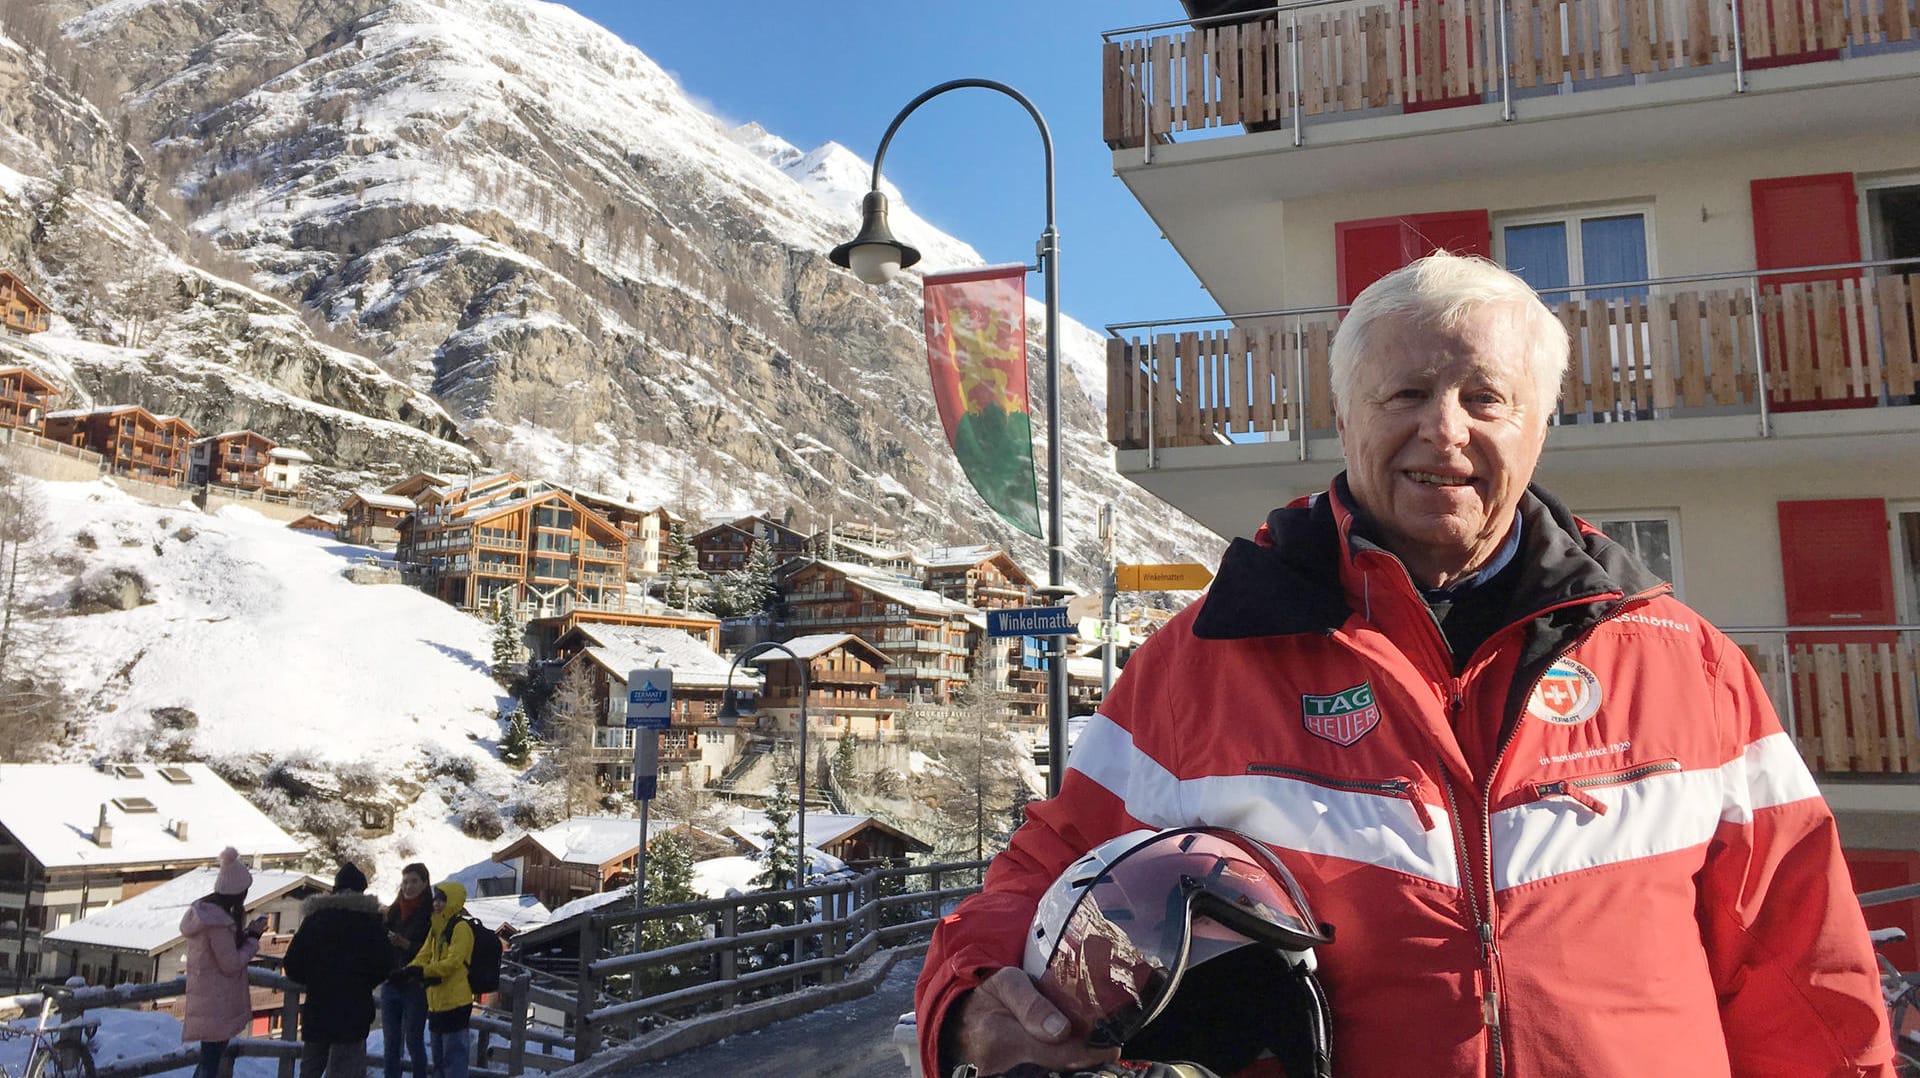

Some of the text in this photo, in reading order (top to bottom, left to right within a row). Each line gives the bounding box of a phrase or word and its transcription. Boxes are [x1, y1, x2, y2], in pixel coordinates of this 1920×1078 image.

[1309, 687, 1372, 714] TAG
[1308, 708, 1376, 741] HEUER
[1539, 756, 1550, 765] in
[1552, 751, 1583, 762] motion
[1585, 745, 1607, 758] since
